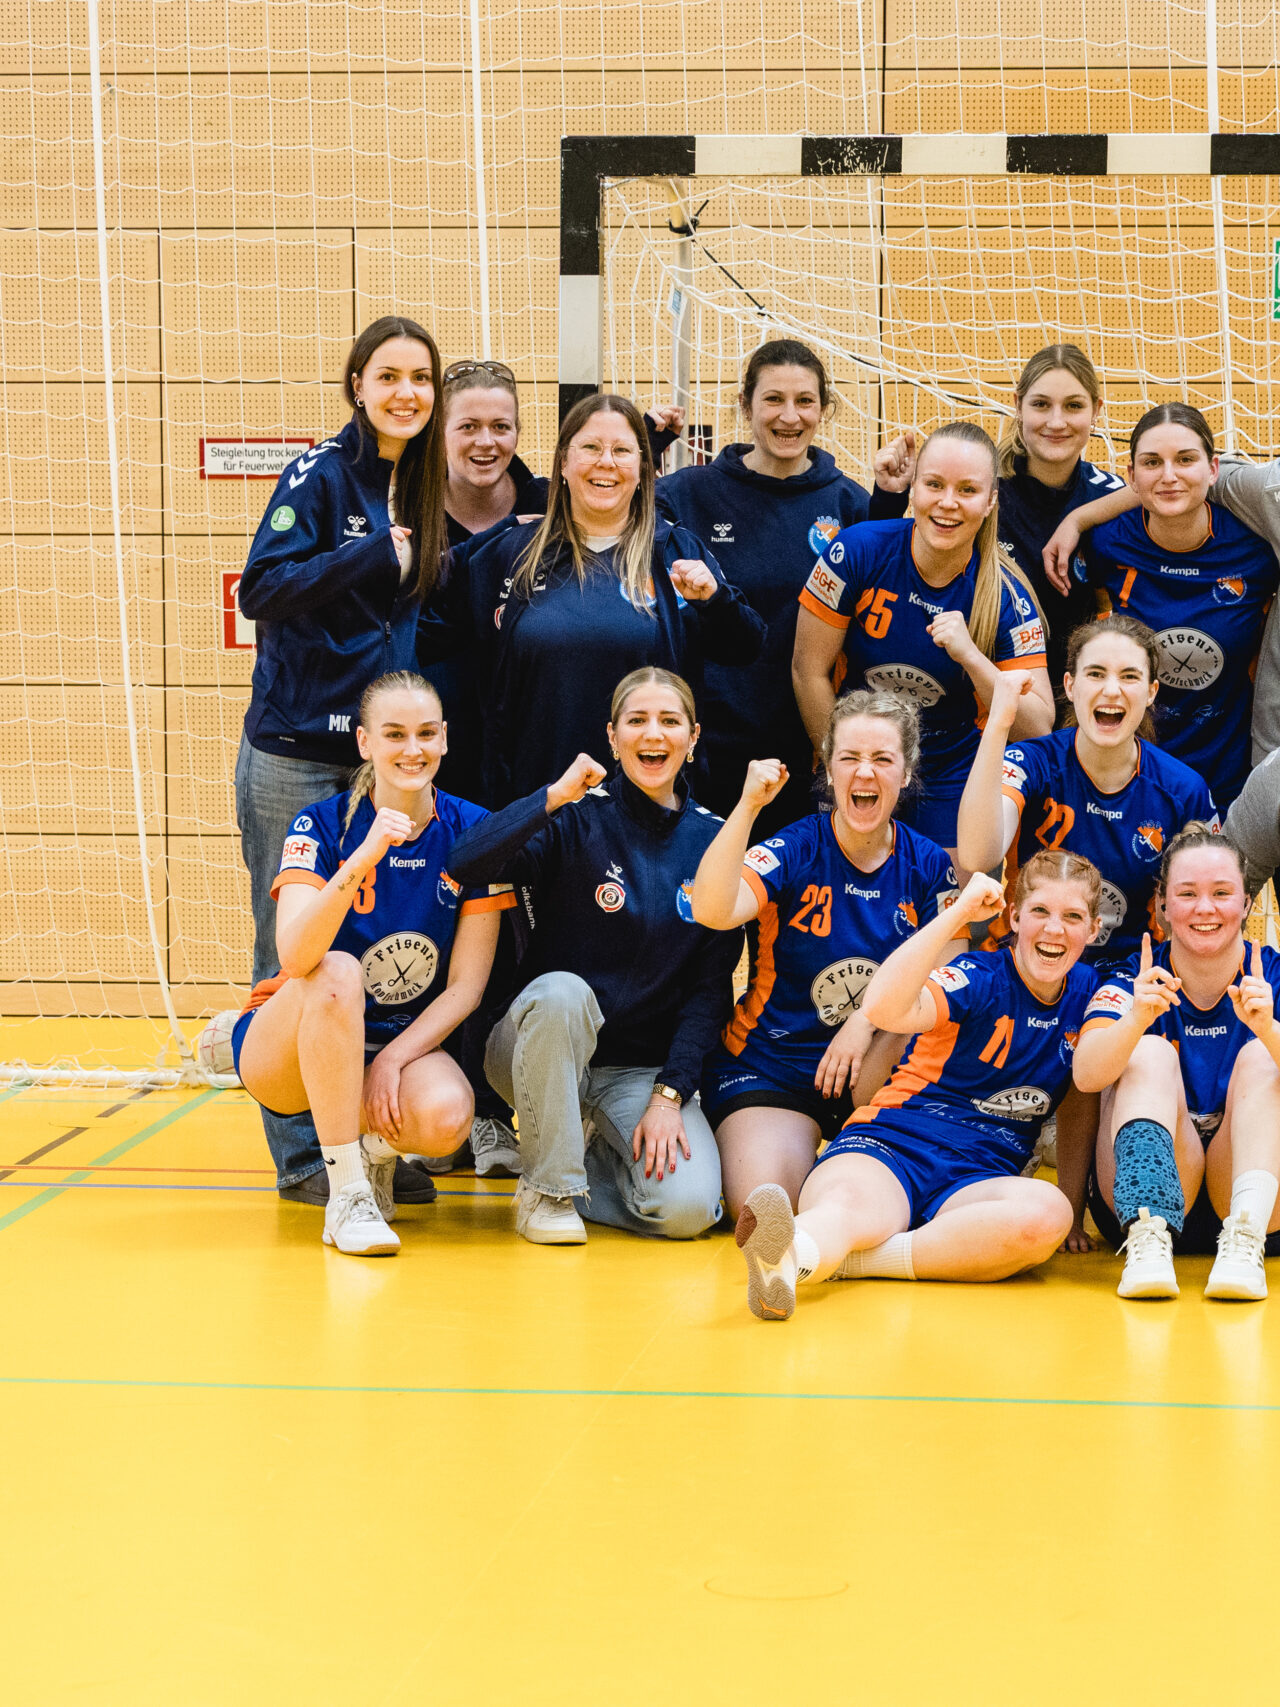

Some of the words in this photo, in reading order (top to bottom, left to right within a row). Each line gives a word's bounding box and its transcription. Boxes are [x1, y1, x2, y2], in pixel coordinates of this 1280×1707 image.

[210, 446, 266, 459] Steigleitung
[267, 446, 302, 458] trocken
[223, 460, 236, 472] für
[711, 534, 735, 543] hummel
[813, 565, 838, 593] BGF
[1160, 565, 1200, 577] Kempa
[908, 592, 944, 615] Kempa
[1160, 634, 1215, 654] riseur
[328, 714, 351, 732] MK
[1086, 802, 1123, 821] Kempa
[1034, 797, 1076, 852] 22
[389, 856, 426, 870] Kempa
[844, 883, 881, 900] Kempa
[788, 884, 833, 938] 23
[373, 938, 434, 962] Friseur
[826, 963, 873, 986] Frise
[1184, 1024, 1228, 1039] Kempa
[978, 1014, 1015, 1070] 11
